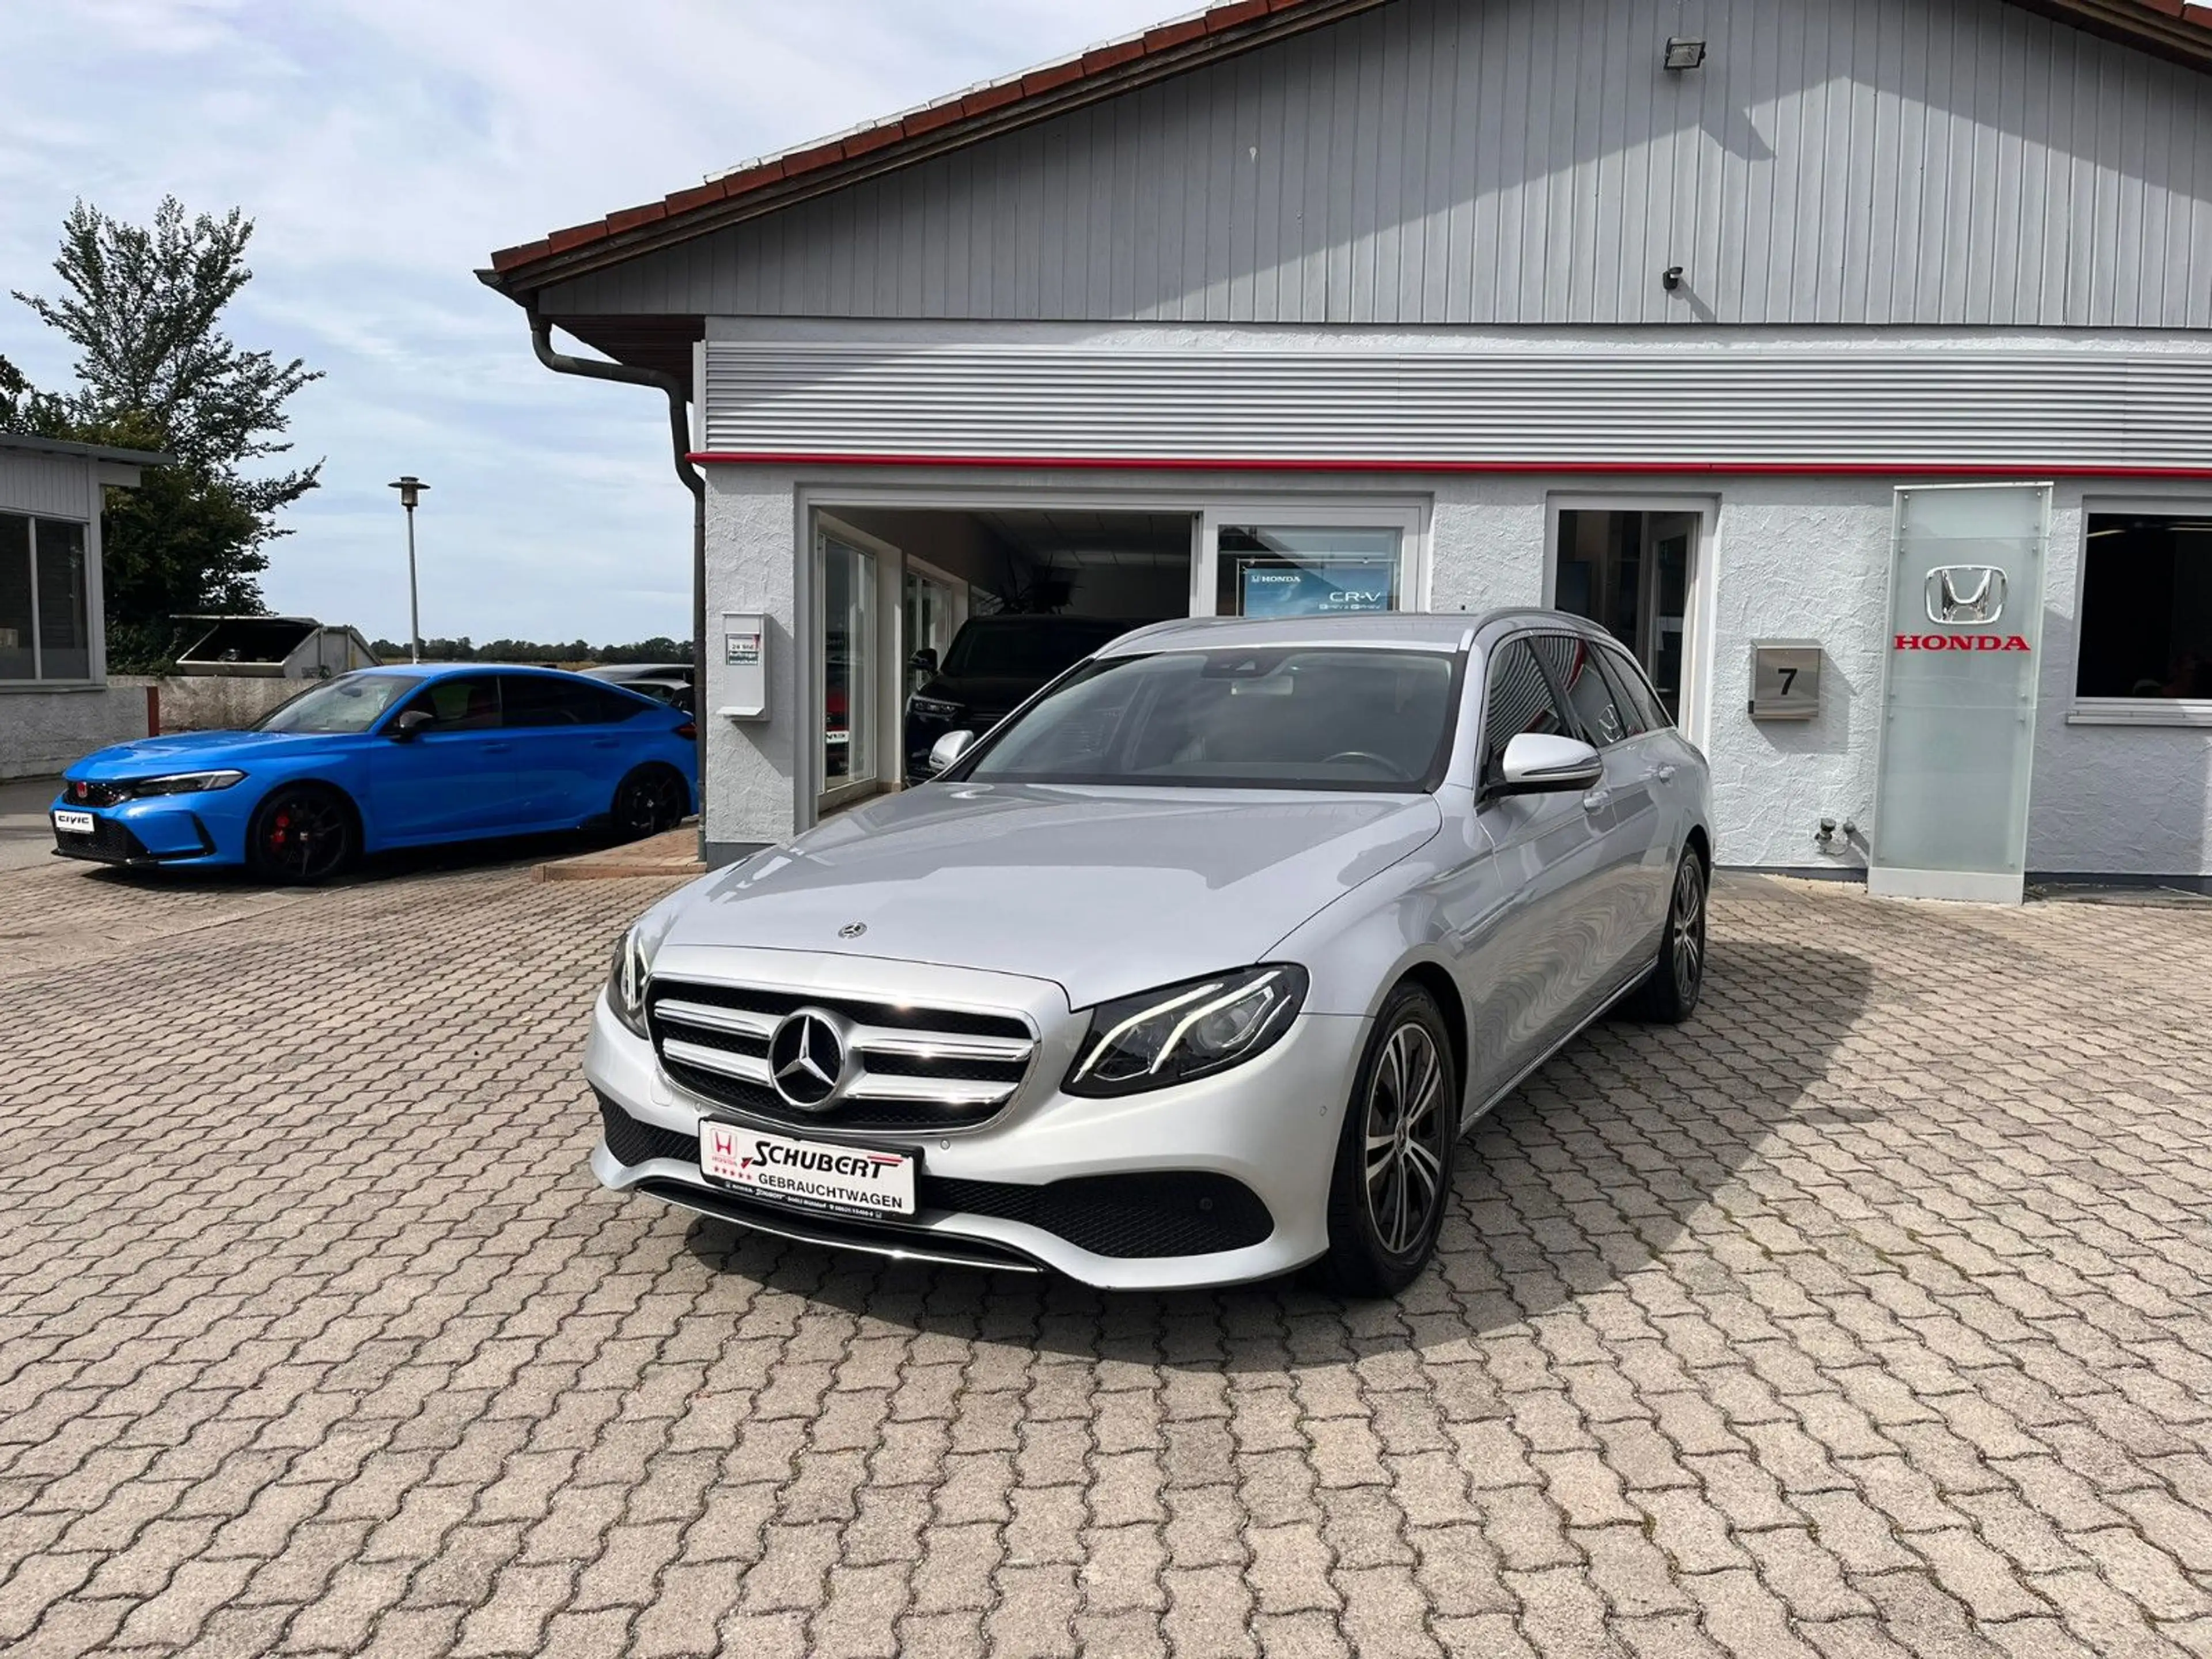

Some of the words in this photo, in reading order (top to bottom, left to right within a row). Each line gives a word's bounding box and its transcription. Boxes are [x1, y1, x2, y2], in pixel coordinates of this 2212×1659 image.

[1330, 591, 1380, 602] CR-V
[1893, 635, 2032, 651] HONDA
[1778, 668, 1798, 696] 7
[58, 815, 89, 824] CIVIC
[751, 1140, 900, 1179] SCHUBERT
[758, 1173, 903, 1209] GEBRAUCHTWAGEN
